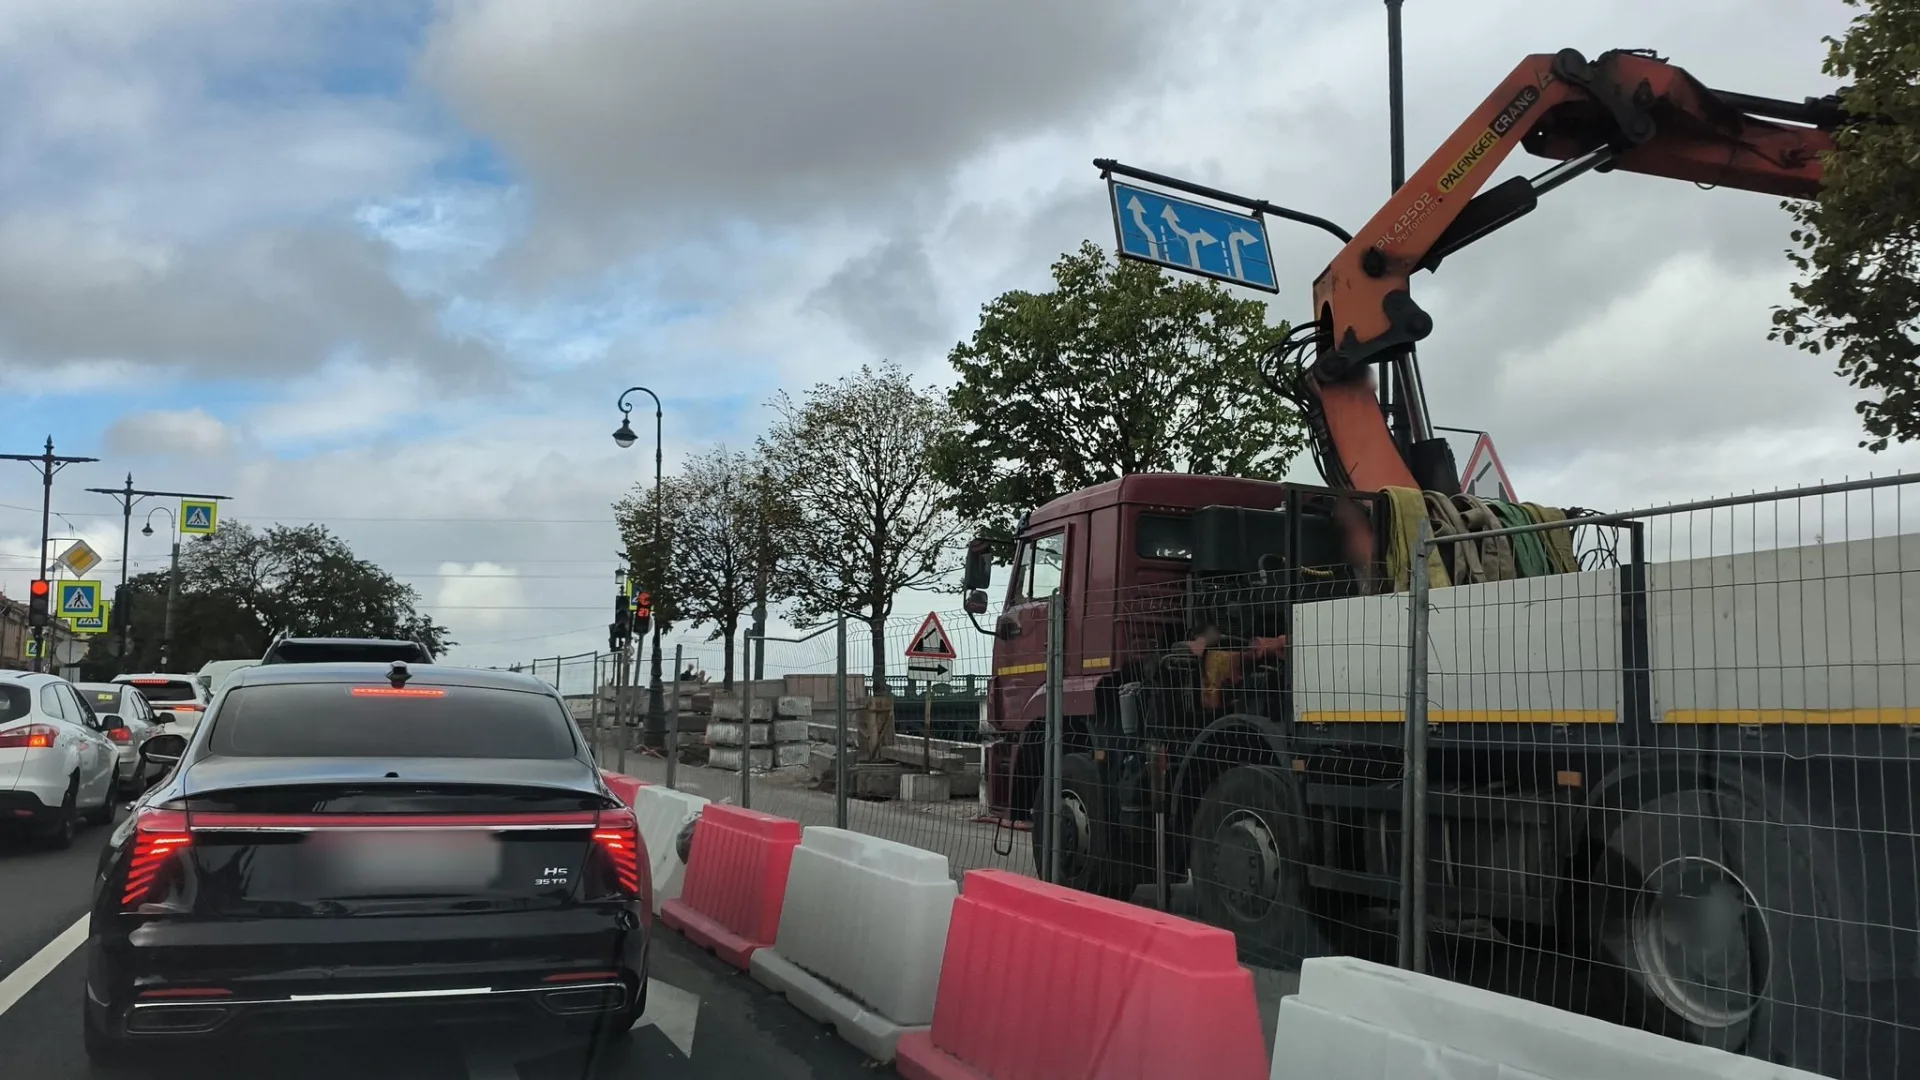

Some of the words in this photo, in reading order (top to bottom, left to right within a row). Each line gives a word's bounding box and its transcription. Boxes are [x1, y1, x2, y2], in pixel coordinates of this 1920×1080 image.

[1440, 131, 1497, 190] PALFINGER
[1494, 89, 1536, 133] CRANE
[1375, 231, 1396, 249] PK
[1394, 192, 1433, 234] 42502
